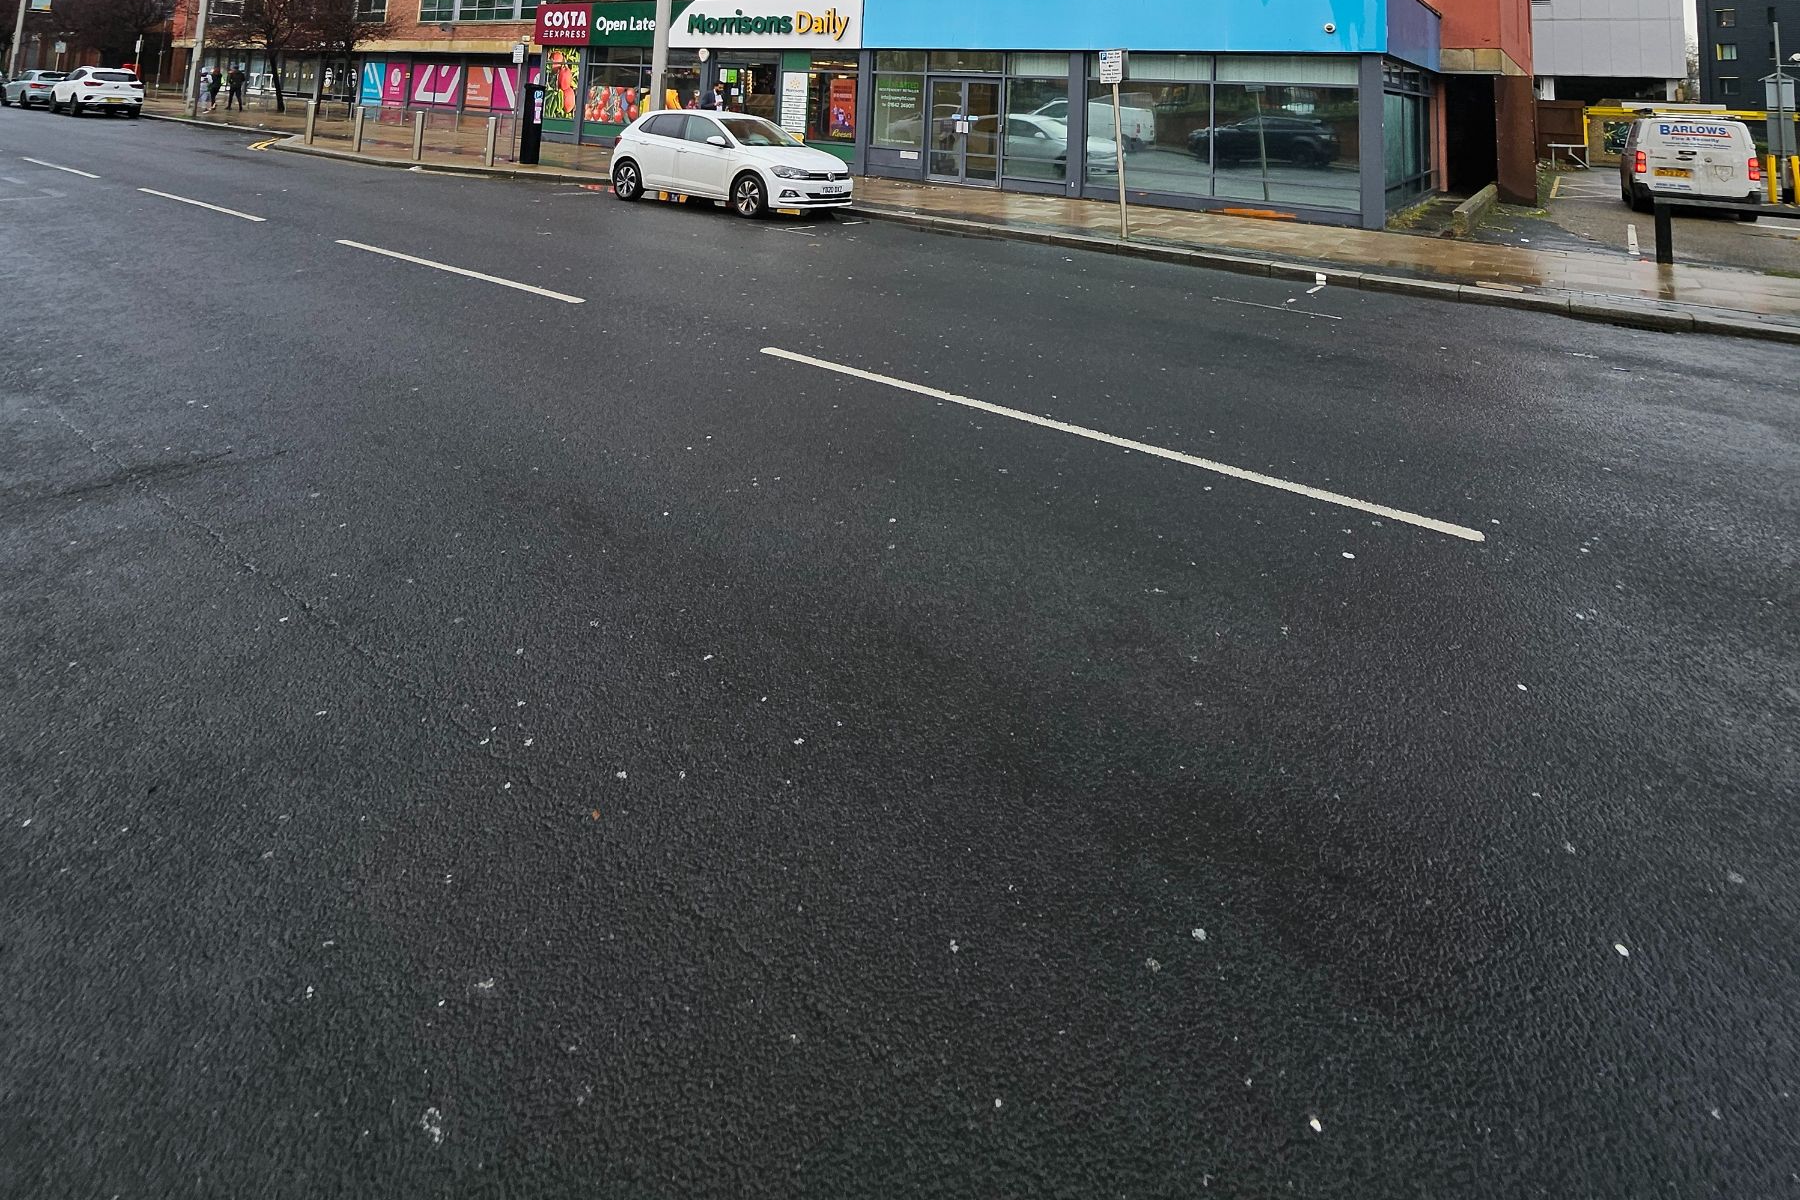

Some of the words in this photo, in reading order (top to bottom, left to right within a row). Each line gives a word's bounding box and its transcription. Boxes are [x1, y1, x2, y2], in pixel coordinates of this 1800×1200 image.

[544, 11, 587, 28] COSTA
[596, 16, 627, 36] Open
[630, 16, 656, 31] Late
[687, 8, 793, 35] Morrisons
[795, 8, 850, 41] Daily
[548, 30, 586, 38] EXPRESS
[1660, 125, 1727, 135] BARLOWS
